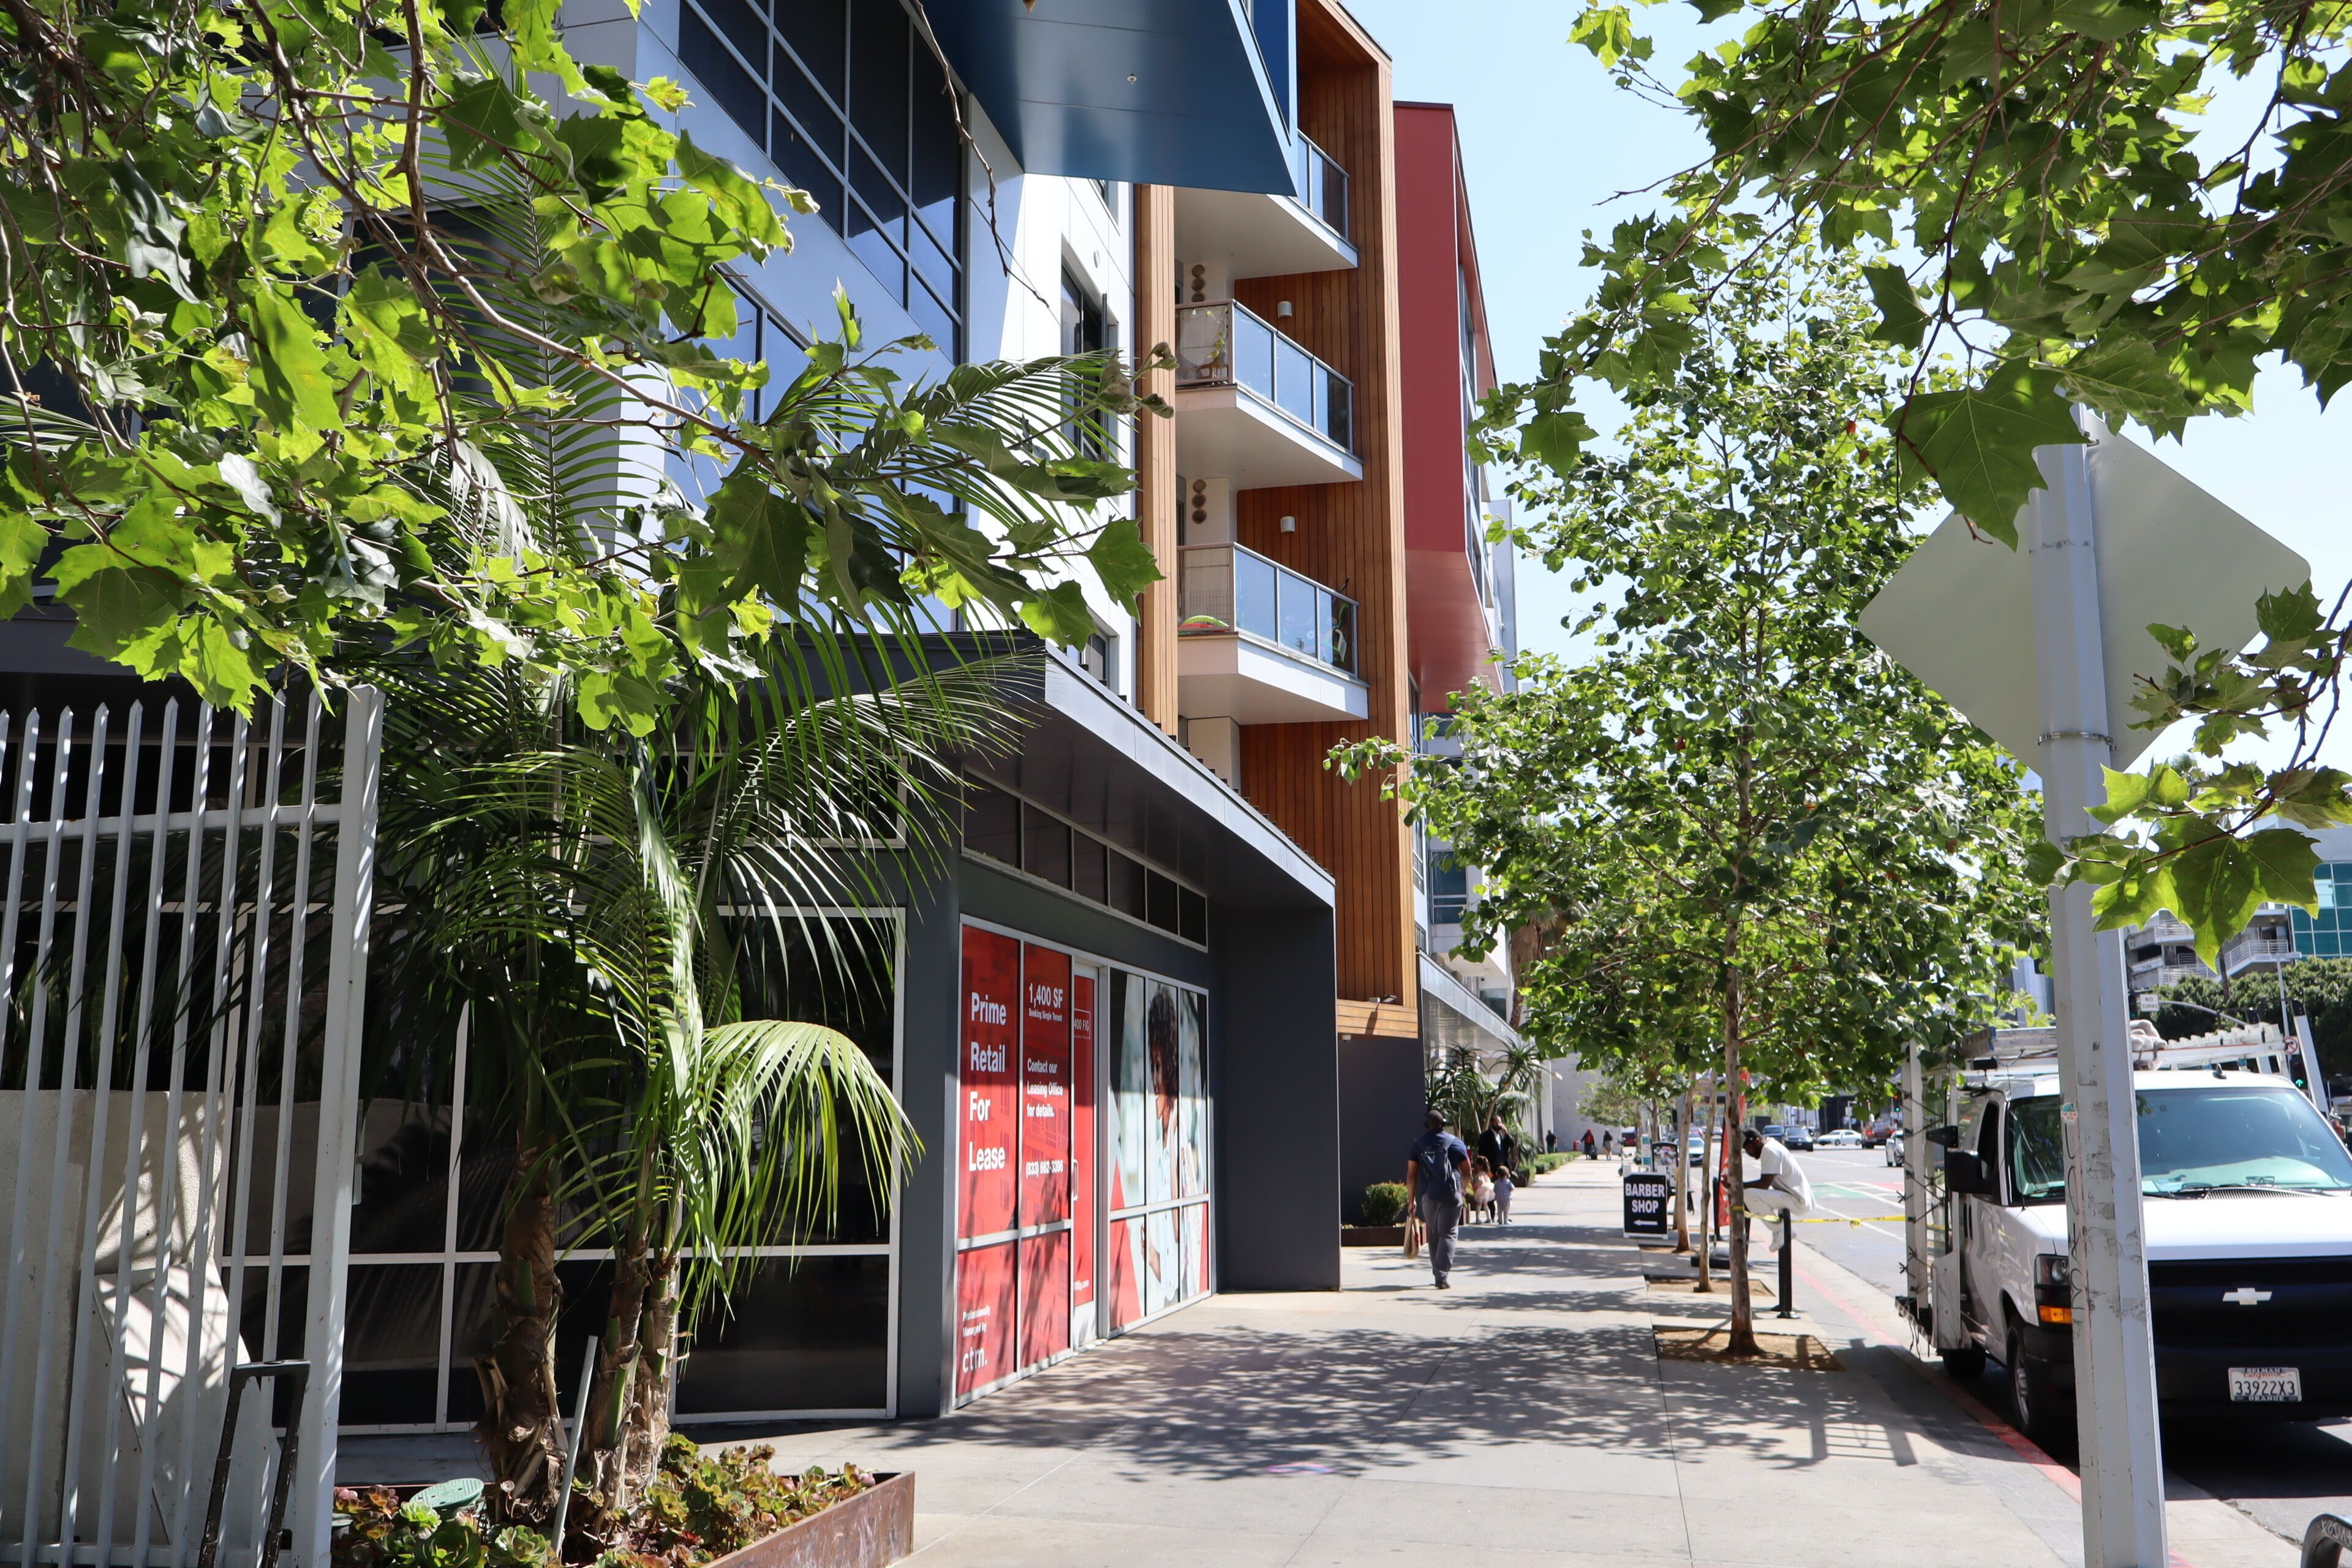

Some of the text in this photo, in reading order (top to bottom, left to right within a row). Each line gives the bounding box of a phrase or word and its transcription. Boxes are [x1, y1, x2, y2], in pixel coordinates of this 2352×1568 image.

[1029, 982, 1063, 1008] 1,400 SF
[971, 992, 1007, 1026] Prime
[970, 1041, 1006, 1073] Retail
[1027, 1058, 1058, 1074] Contact our
[1027, 1080, 1063, 1098] Leasing Office
[969, 1091, 991, 1121] For
[1027, 1102, 1055, 1118] for details.
[968, 1141, 1006, 1172] Lease
[1025, 1161, 1039, 1179] (833)
[1625, 1183, 1665, 1197] BARBER
[1632, 1200, 1659, 1213] SHOP
[981, 1322, 987, 1333] by
[2235, 1381, 2295, 1396] 33922X3
